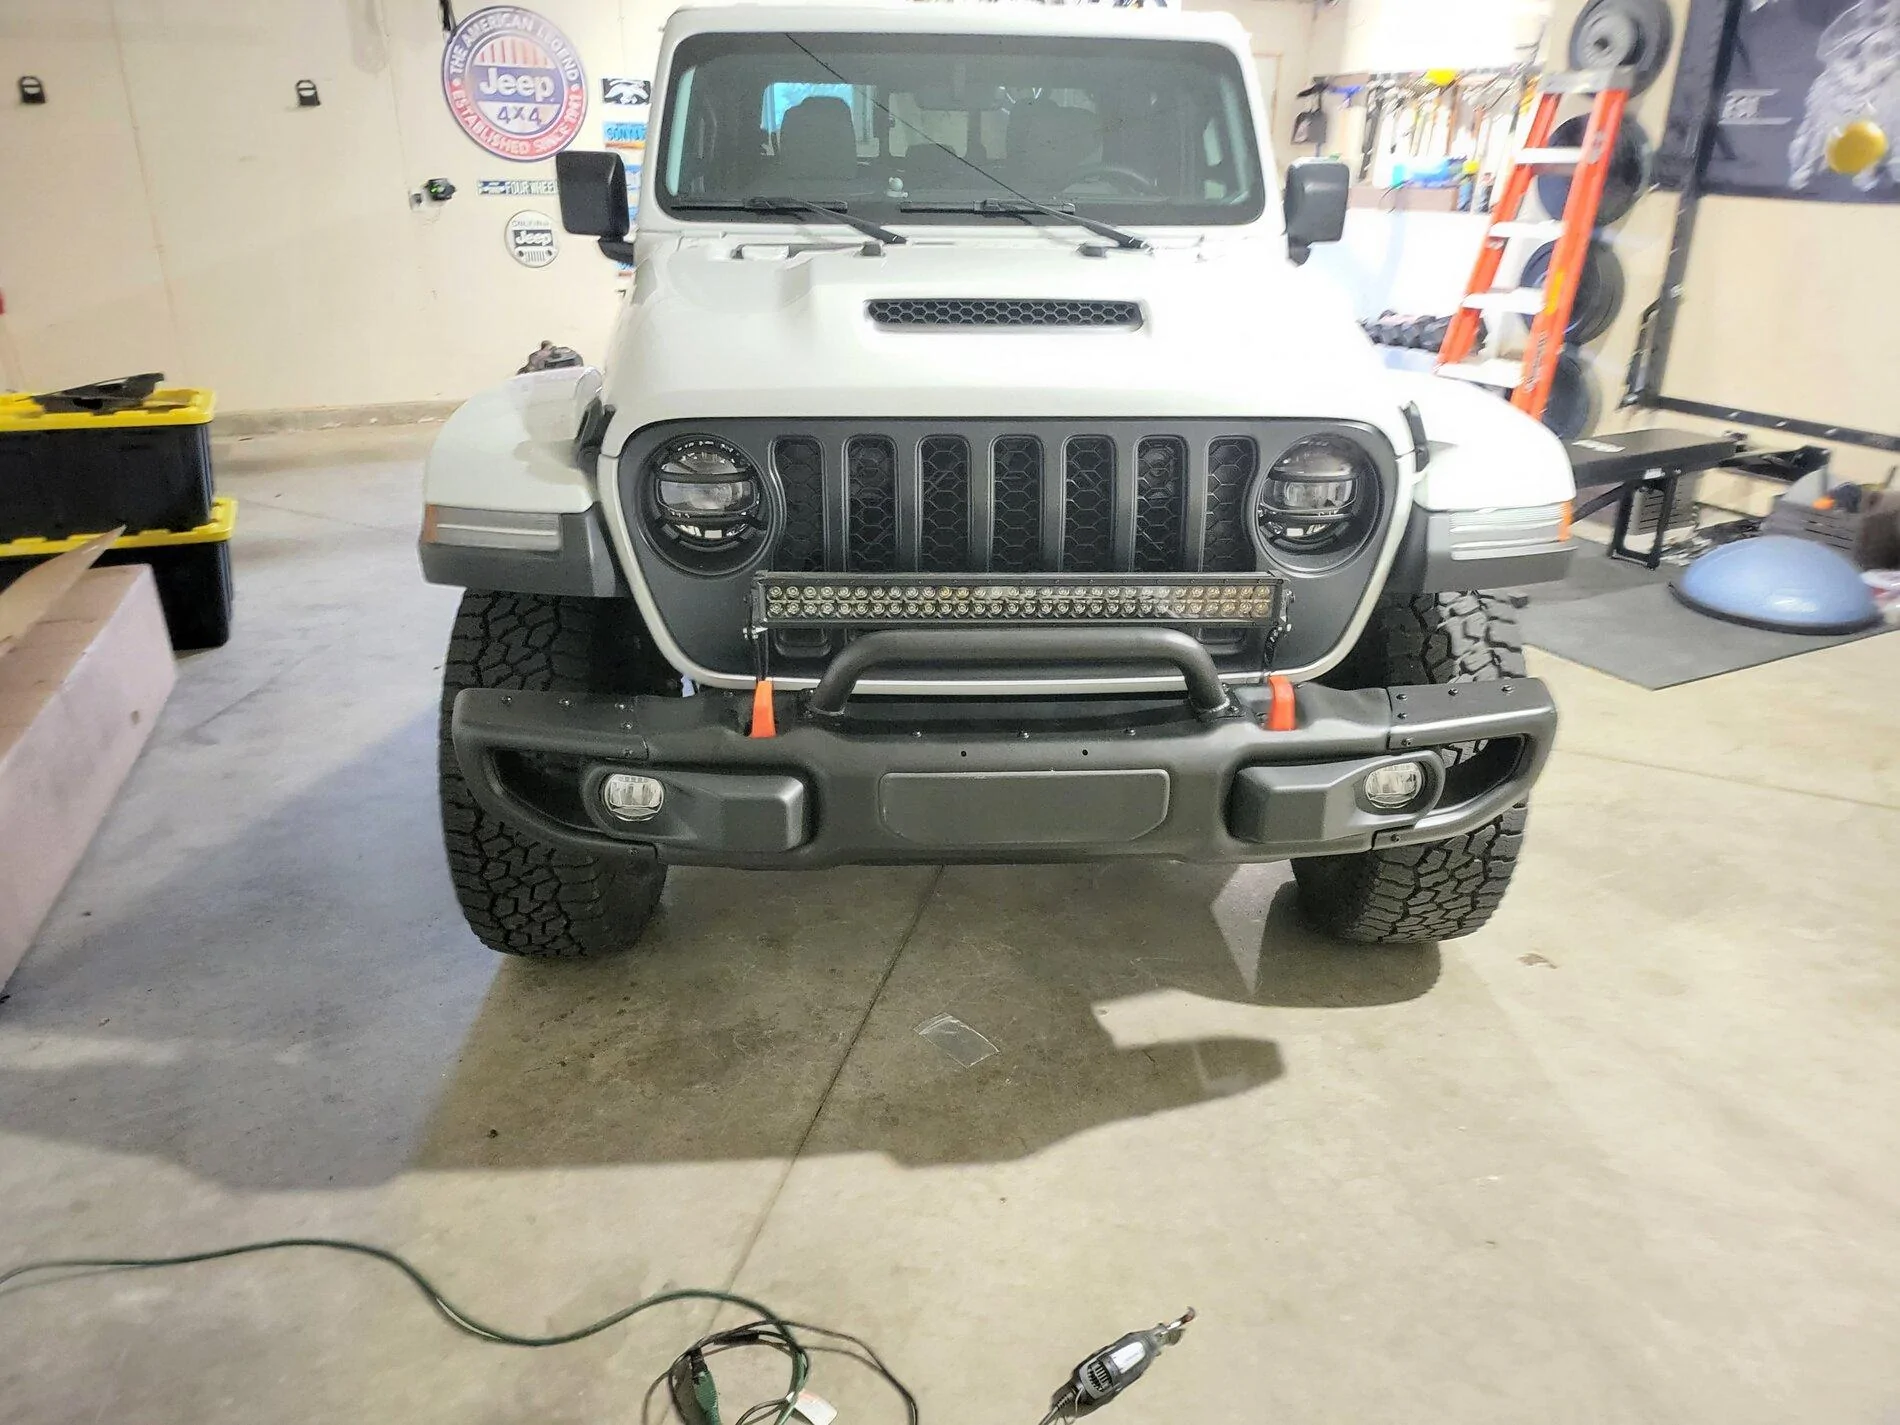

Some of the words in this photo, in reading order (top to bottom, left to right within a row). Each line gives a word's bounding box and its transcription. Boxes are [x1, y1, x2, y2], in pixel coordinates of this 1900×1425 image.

[450, 44, 469, 75] THE
[461, 13, 534, 48] AMERICAN
[479, 67, 555, 102] Jeep
[515, 230, 552, 247] Jeep
